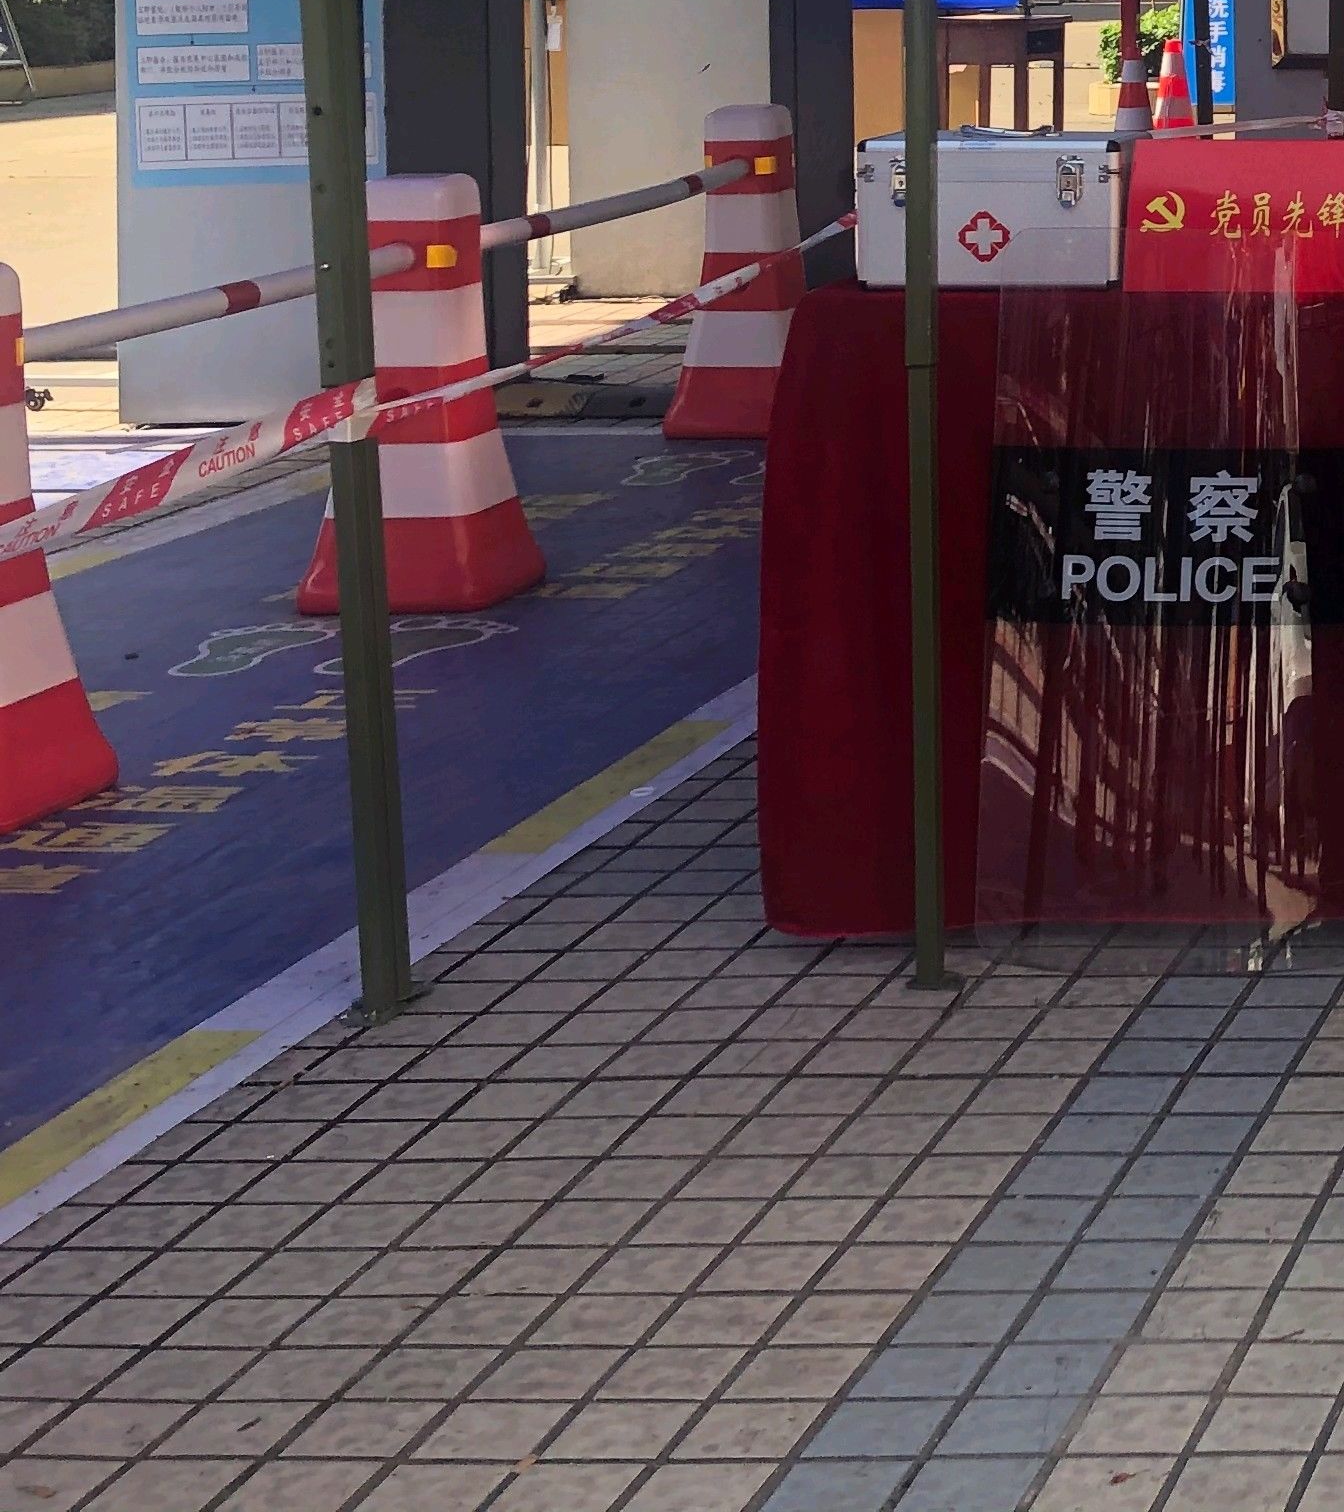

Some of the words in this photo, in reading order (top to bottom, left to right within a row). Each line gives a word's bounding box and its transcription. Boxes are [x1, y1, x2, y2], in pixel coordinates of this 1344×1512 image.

[198, 440, 257, 479] CAUTION
[102, 482, 161, 519] SAFE
[1085, 469, 1259, 543] 警察
[1061, 553, 1282, 603] POLICE
